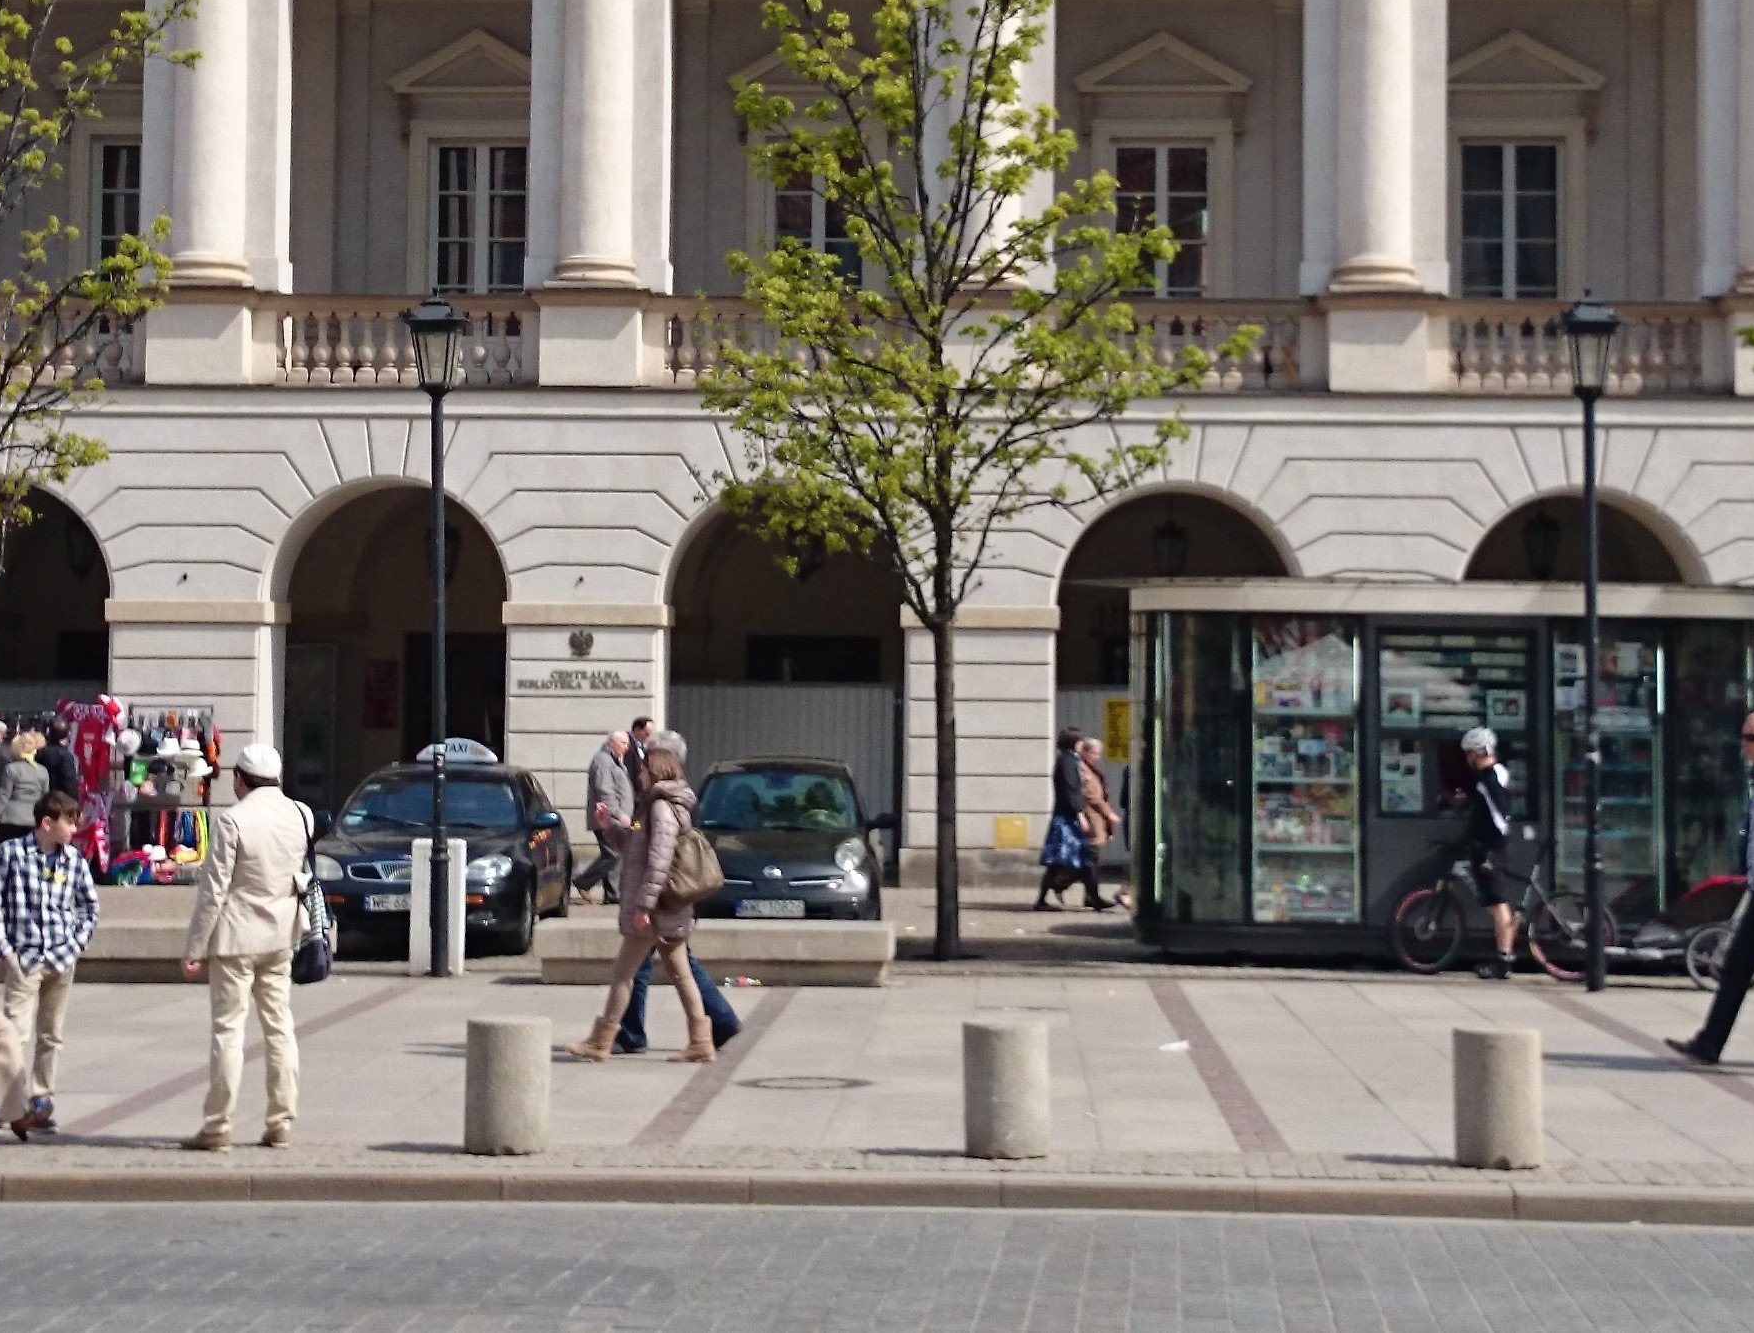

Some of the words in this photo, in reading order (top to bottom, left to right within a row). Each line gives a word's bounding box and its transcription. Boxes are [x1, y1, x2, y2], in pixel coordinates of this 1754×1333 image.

[550, 670, 620, 680] CENTRALNA
[517, 679, 583, 690] BIBLIOTEKA
[590, 679, 645, 690] ROLNICZA
